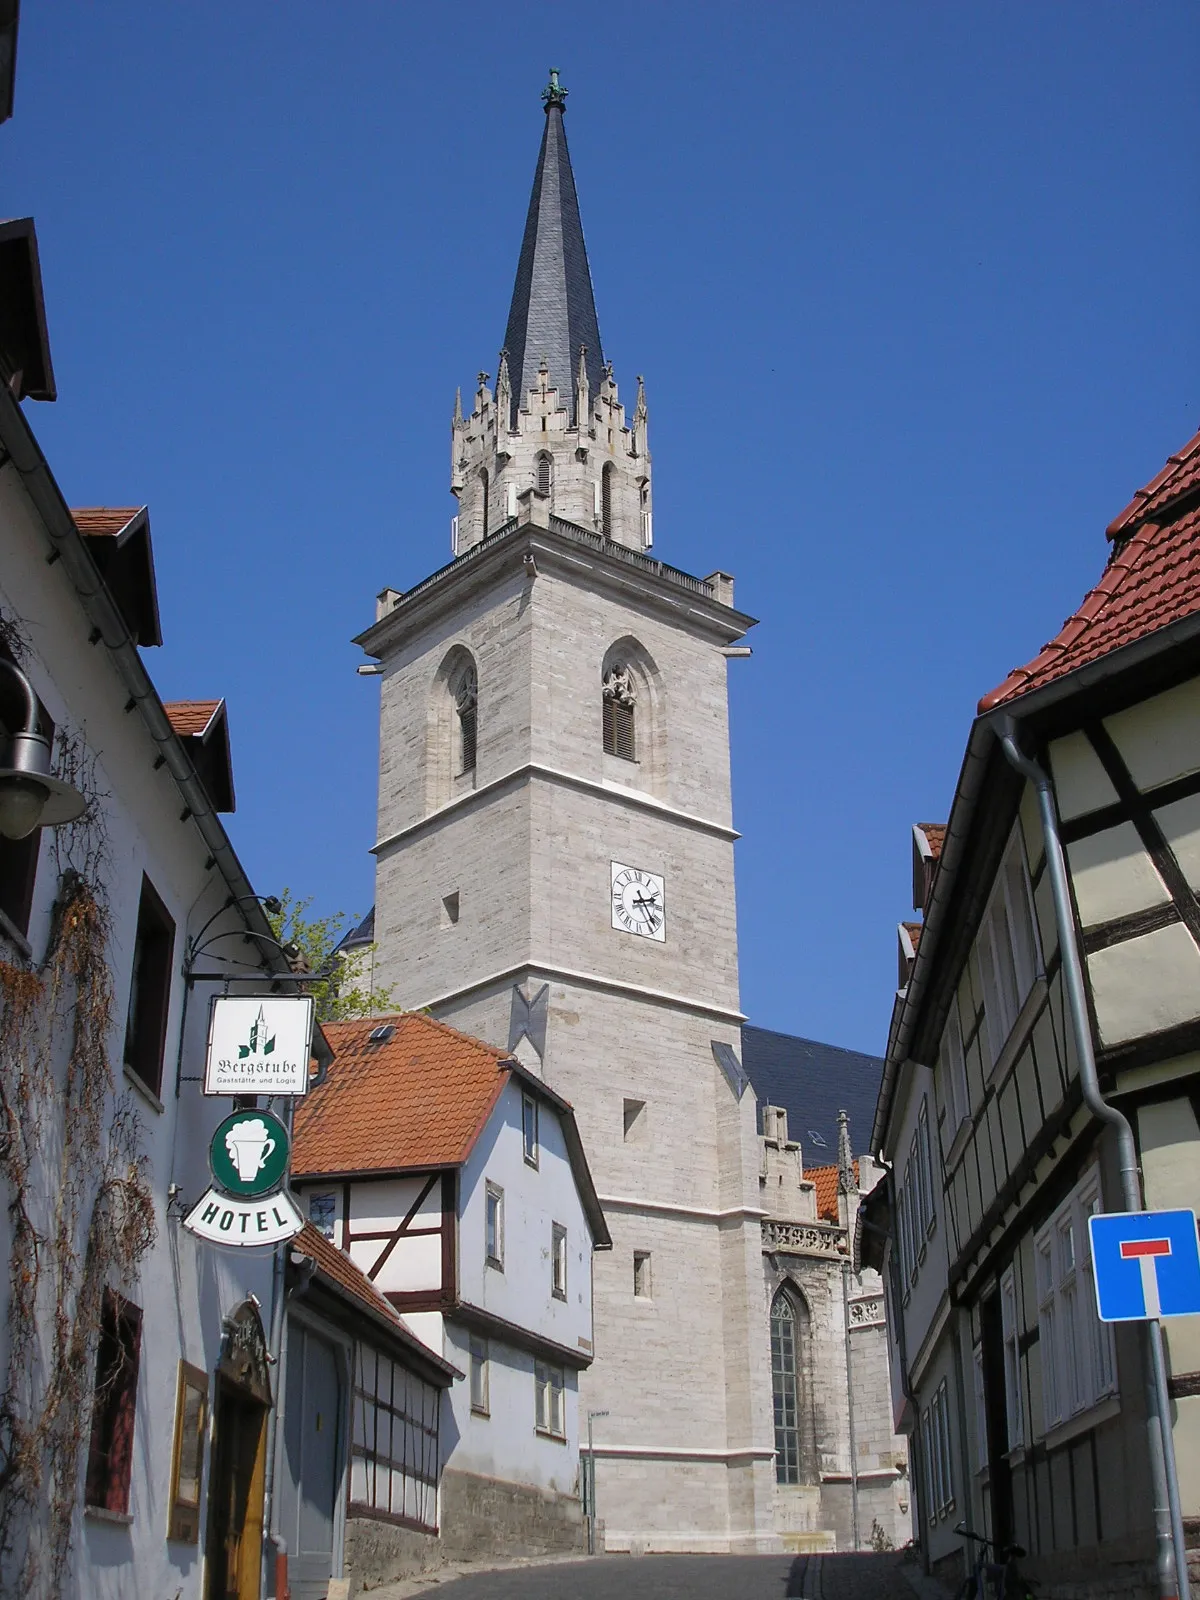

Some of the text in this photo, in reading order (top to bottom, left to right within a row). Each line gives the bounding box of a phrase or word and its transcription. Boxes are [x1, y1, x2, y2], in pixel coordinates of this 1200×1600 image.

[217, 1060, 297, 1075] Bergstube
[275, 1077, 296, 1085] Logis
[201, 1203, 288, 1232] HOTEL
